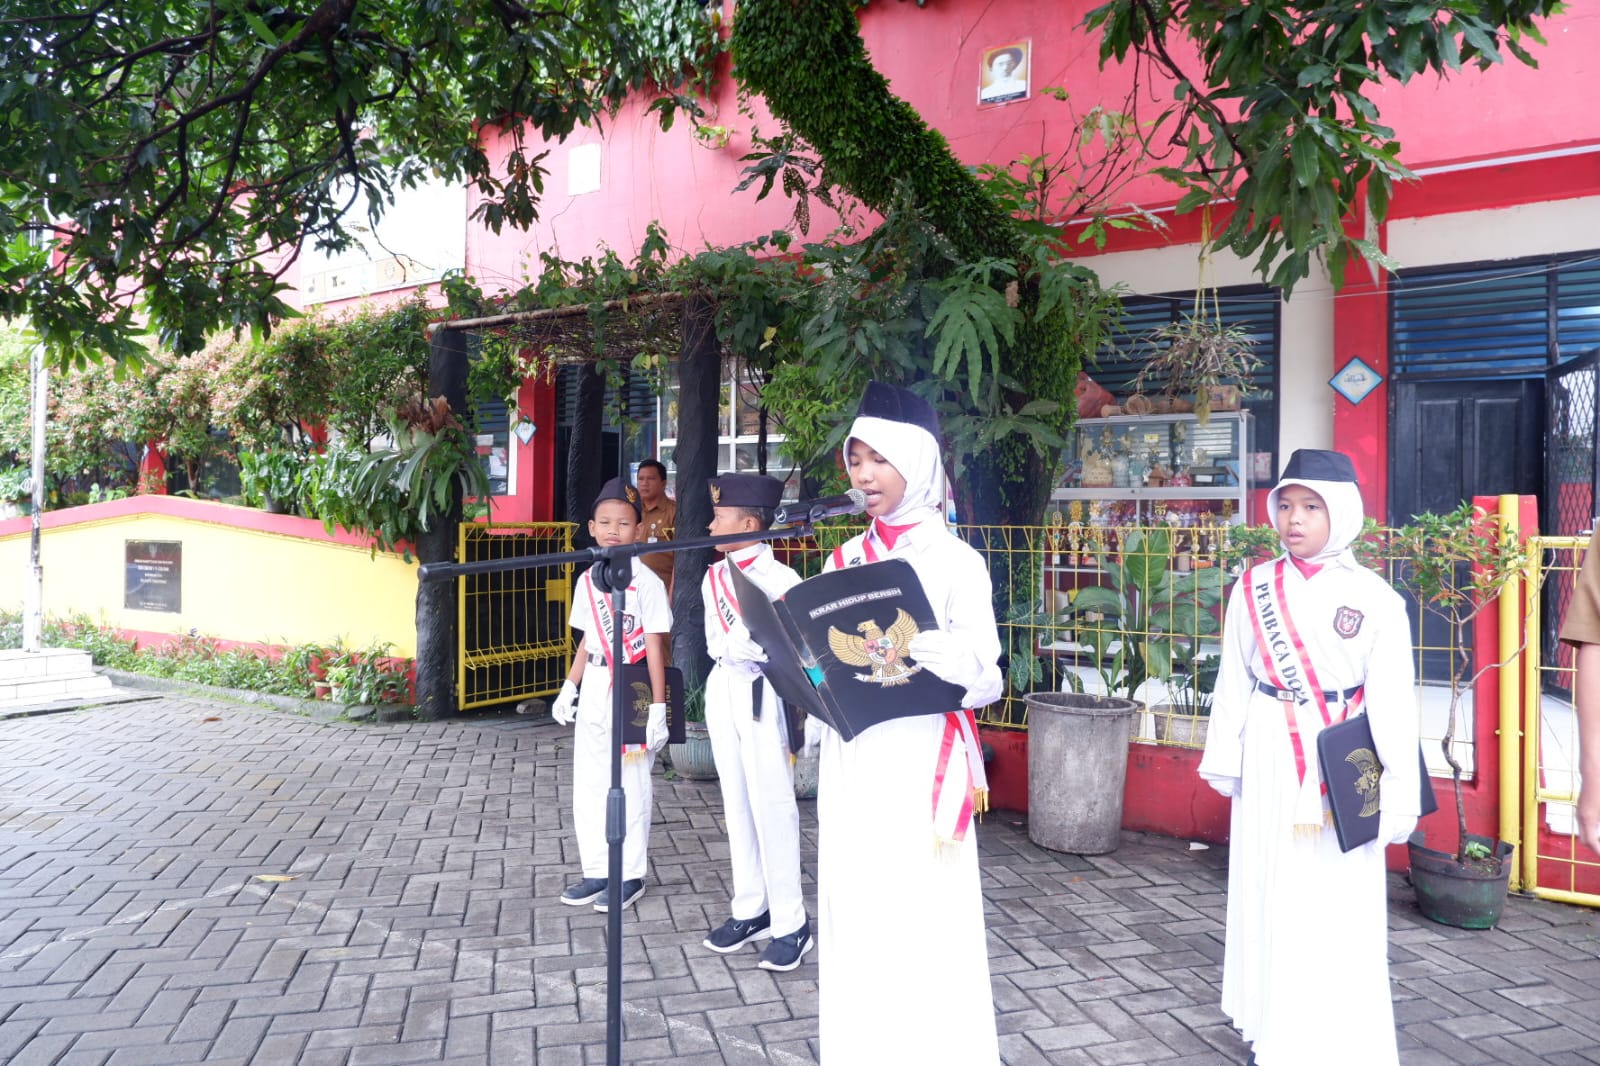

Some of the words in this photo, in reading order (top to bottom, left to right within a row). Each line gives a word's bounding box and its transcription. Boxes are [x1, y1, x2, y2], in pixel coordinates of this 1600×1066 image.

[809, 603, 839, 619] IKRAR
[838, 595, 867, 608] HIDUP
[868, 588, 902, 600] BERSIH
[1255, 582, 1291, 663] PEMBACA
